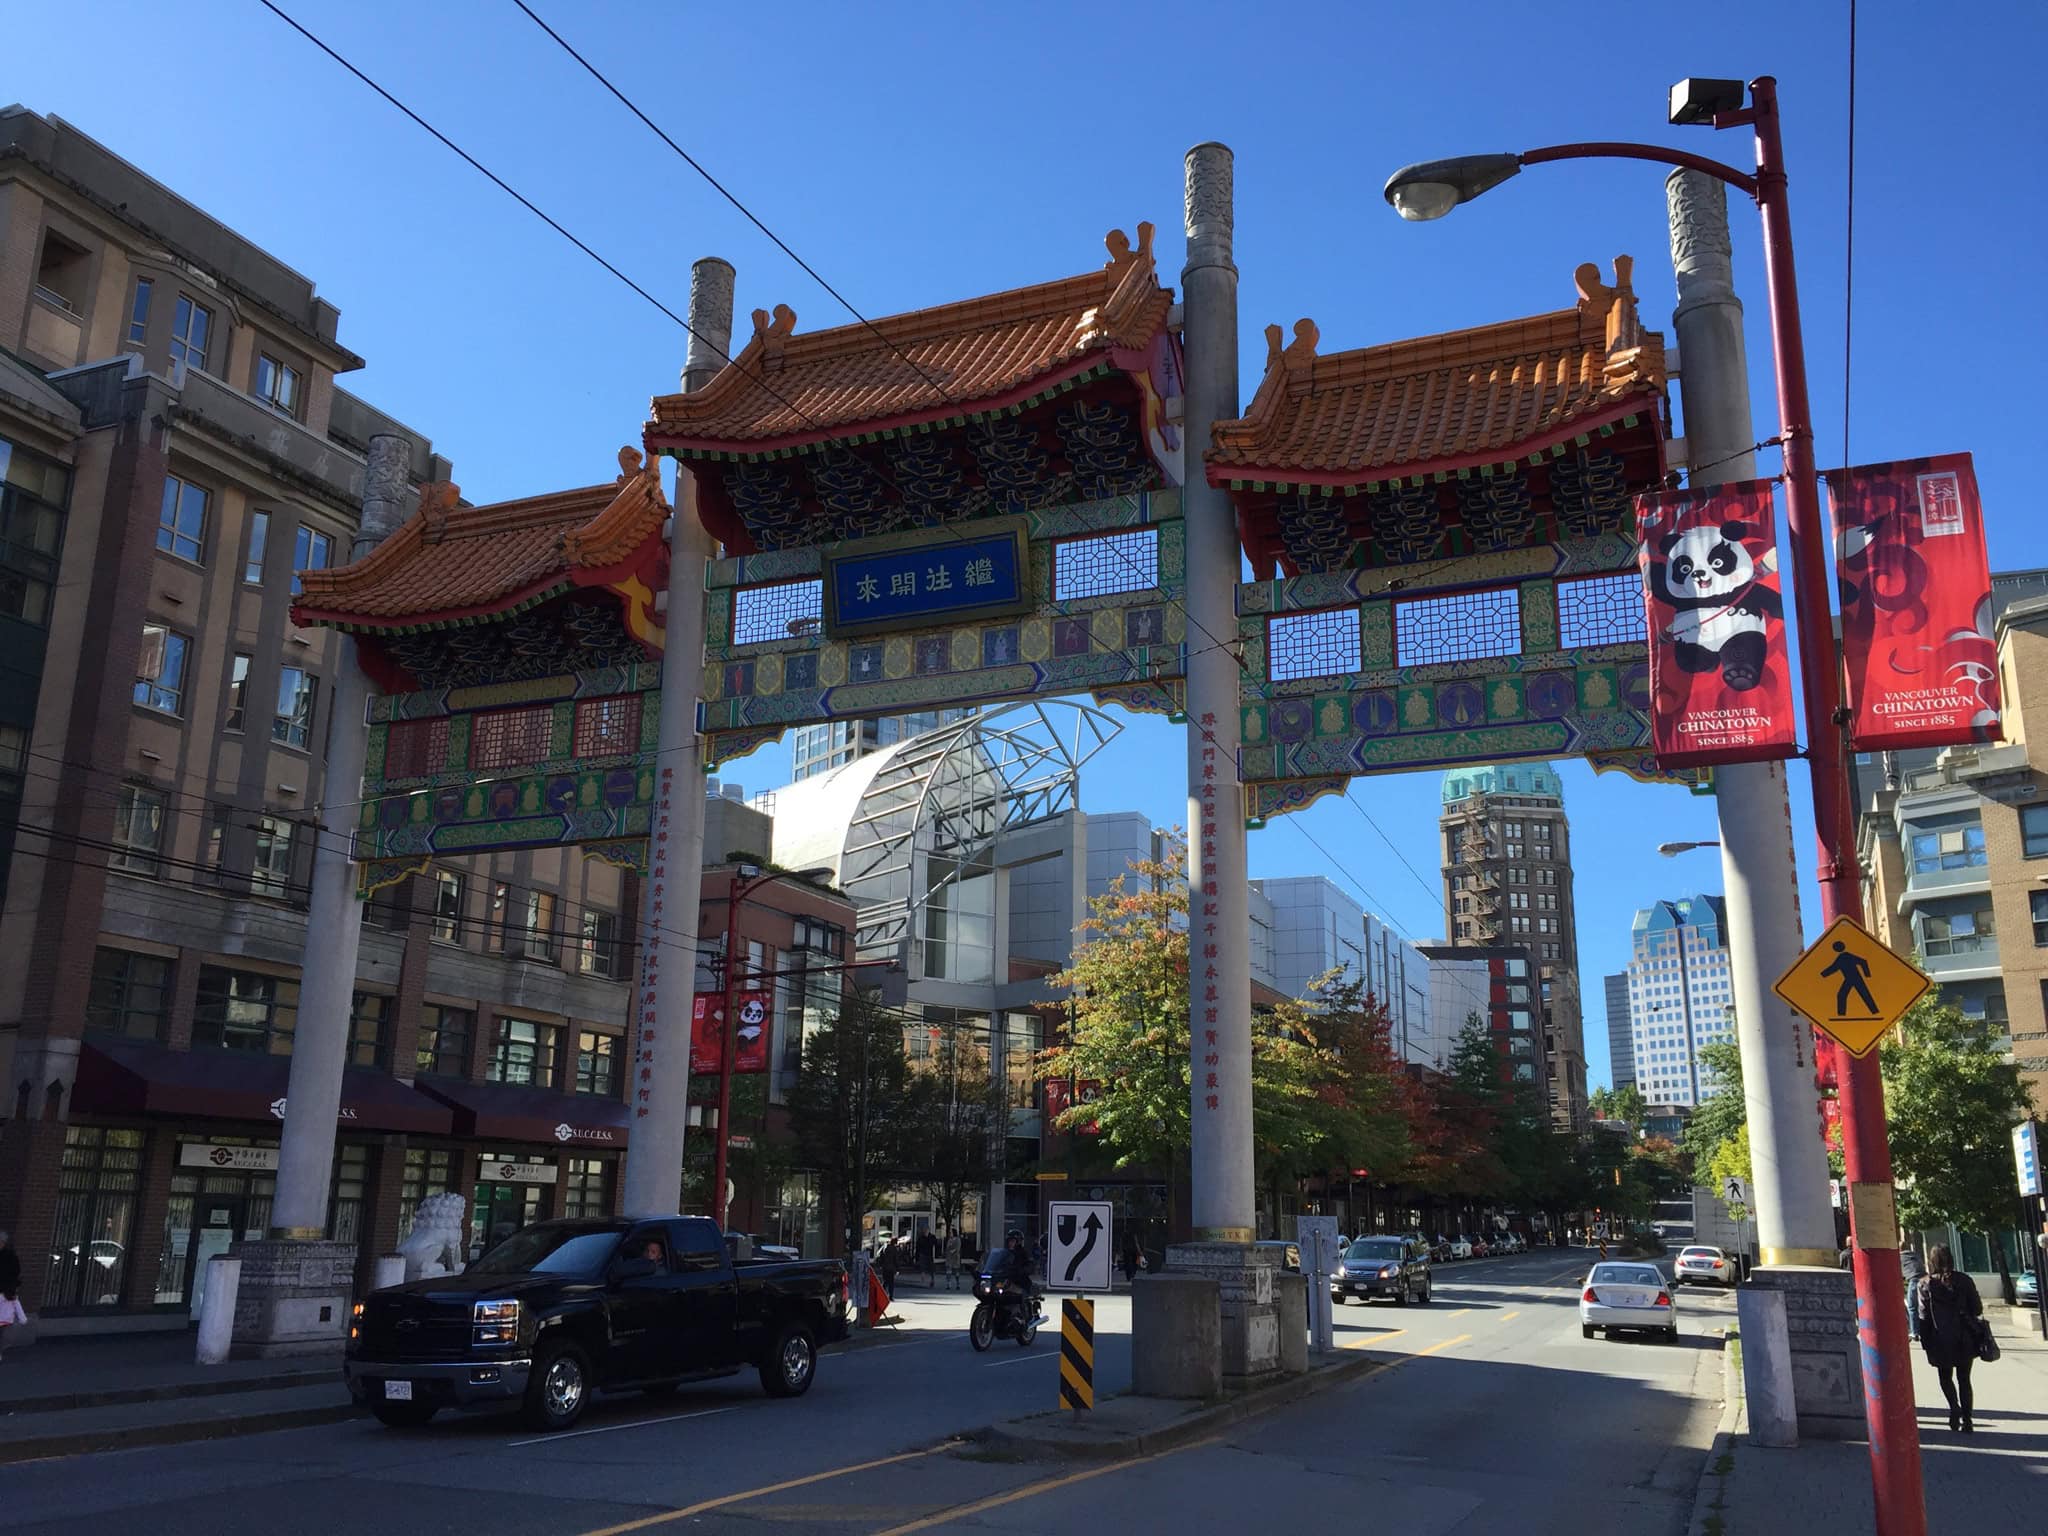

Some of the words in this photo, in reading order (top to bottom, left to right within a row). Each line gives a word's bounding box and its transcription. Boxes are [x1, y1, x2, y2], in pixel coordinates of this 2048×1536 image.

[1885, 686, 1958, 701] VANCOUVER
[1873, 696, 1974, 714] CHINATOWN
[1688, 708, 1758, 720] VANCOUVER
[1894, 718, 1927, 728] SINCE
[1930, 714, 1955, 725] 1885
[1678, 716, 1771, 733] CHINATOWN
